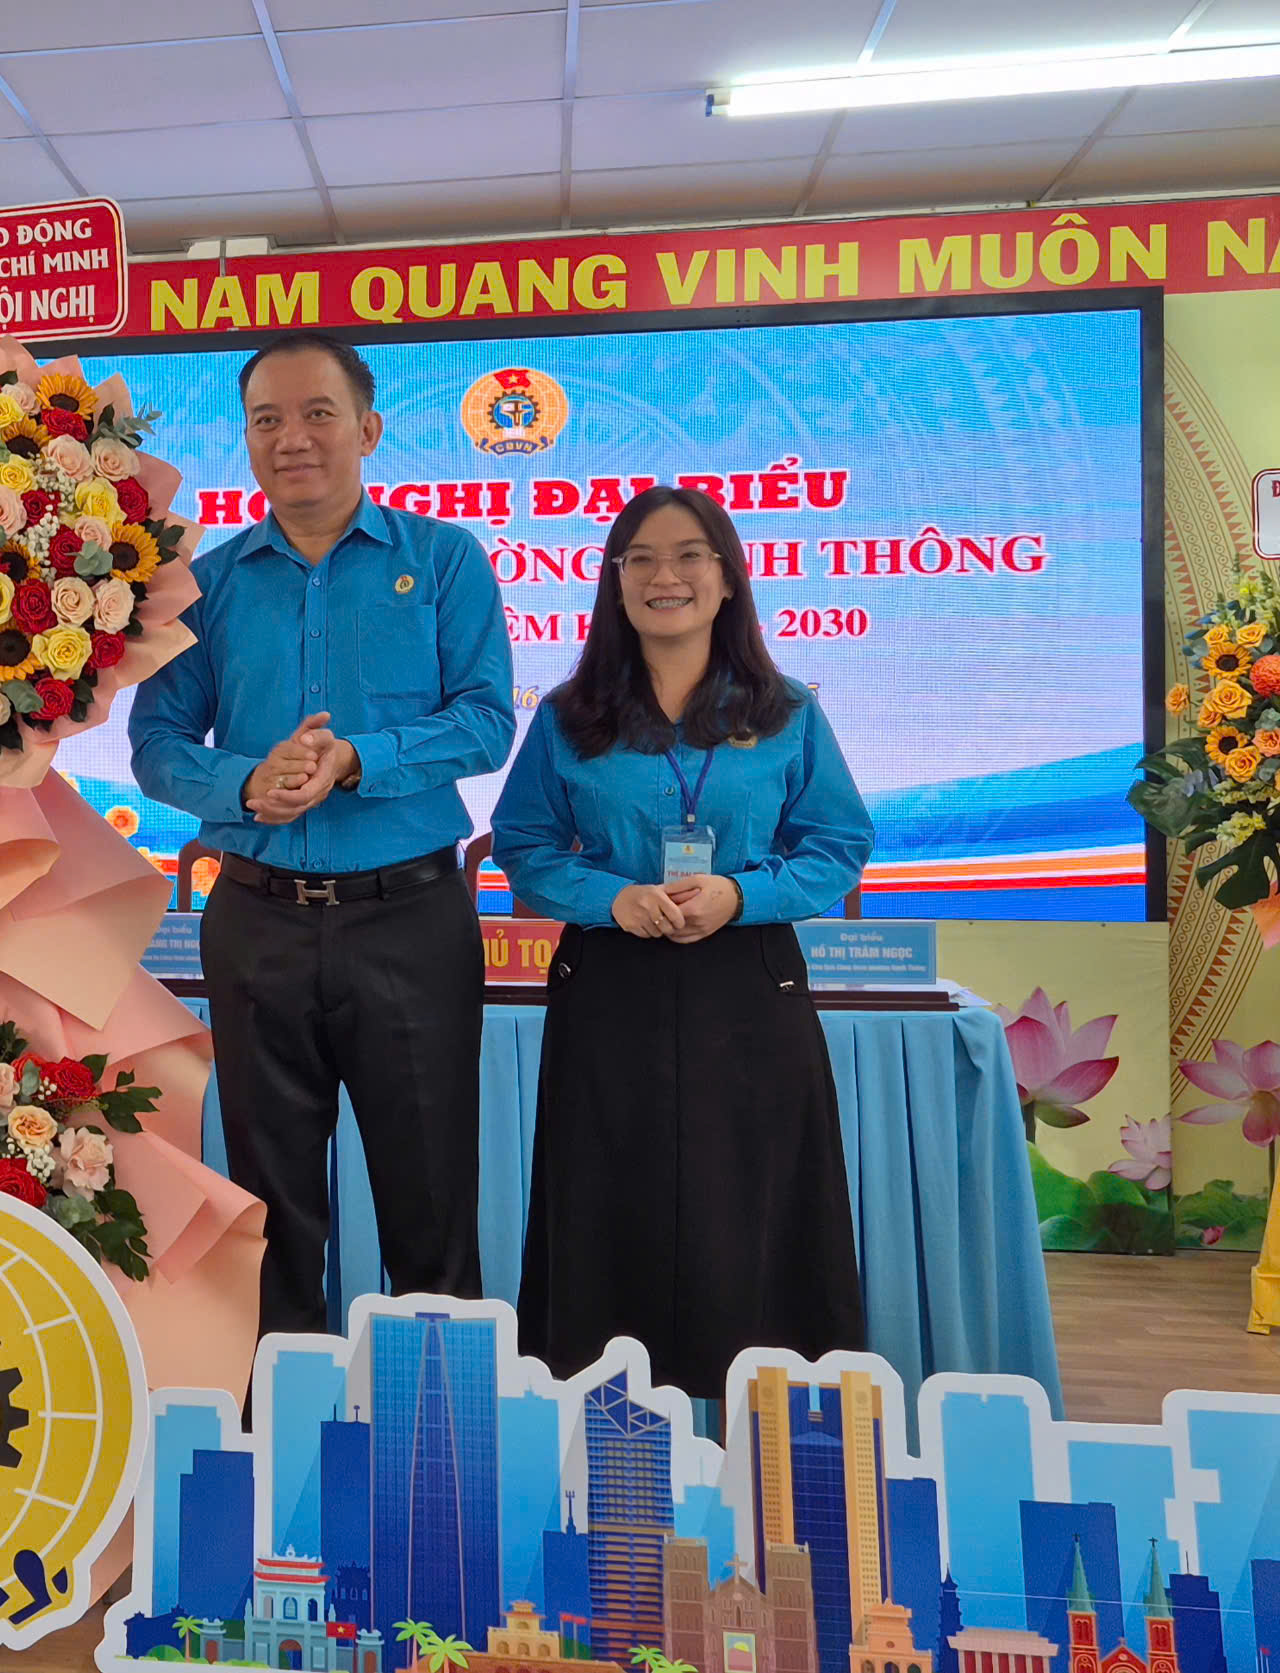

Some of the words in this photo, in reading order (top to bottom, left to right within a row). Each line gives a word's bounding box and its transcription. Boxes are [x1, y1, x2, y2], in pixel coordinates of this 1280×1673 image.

[17, 218, 93, 247] ĐỘNG
[43, 248, 109, 273] MINH
[151, 271, 320, 331] NAM
[350, 254, 628, 325] QUANG
[656, 241, 859, 305] VINH
[899, 212, 1168, 294] MUÔN
[1208, 218, 1280, 276] N
[30, 285, 95, 324] NGHỊ
[820, 526, 1046, 575] THÔNG
[777, 608, 869, 638] 2030
[517, 938, 560, 974] TỌ
